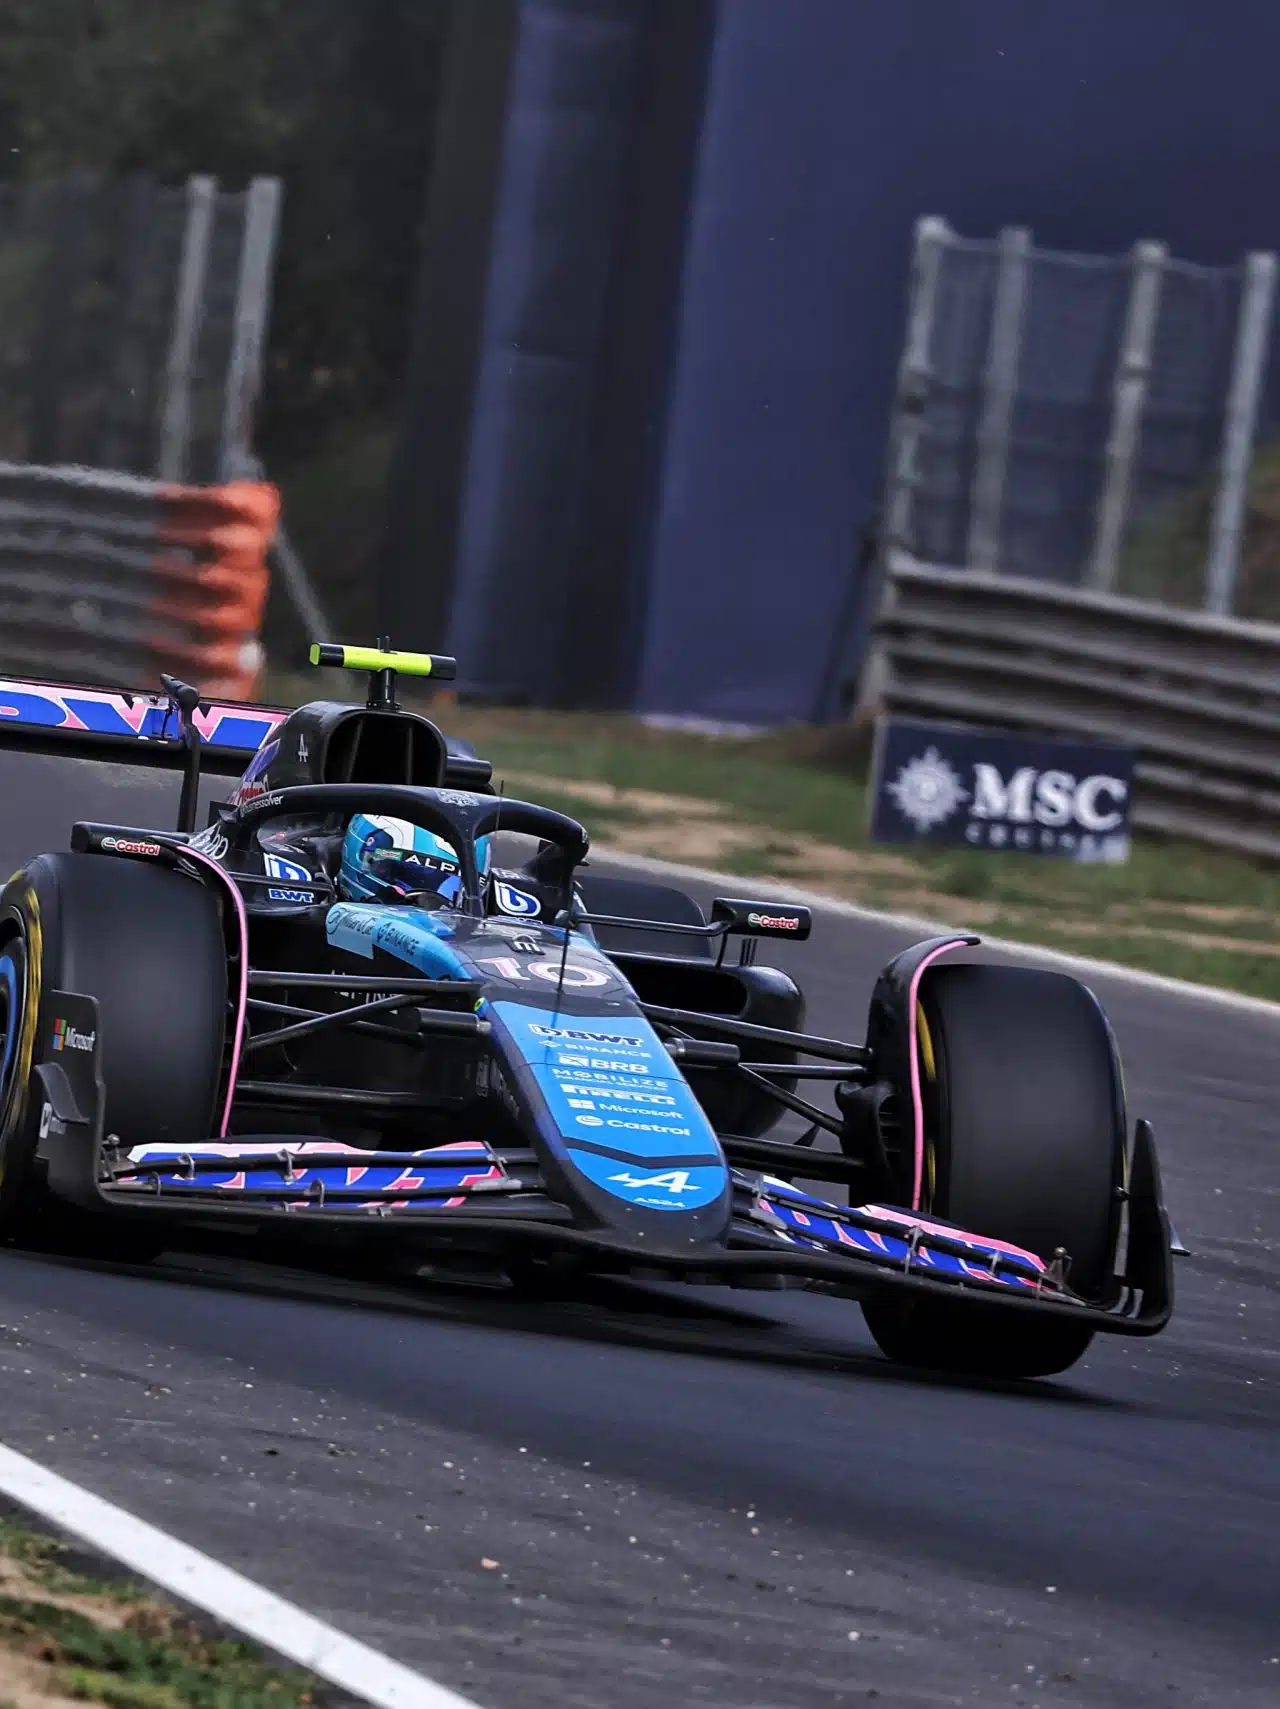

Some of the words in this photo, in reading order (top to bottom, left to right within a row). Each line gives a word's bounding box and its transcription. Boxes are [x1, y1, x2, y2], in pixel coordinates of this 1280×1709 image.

[970, 763, 1128, 831] MSC
[115, 839, 160, 856] Castrol
[268, 888, 315, 904] BWT
[759, 915, 799, 930] Castrol
[474, 956, 612, 987] 10
[564, 1043, 652, 1059] BINANCE
[590, 1059, 650, 1074] BRB
[599, 1103, 685, 1120] Microsoft
[607, 1118, 691, 1137] Castrol
